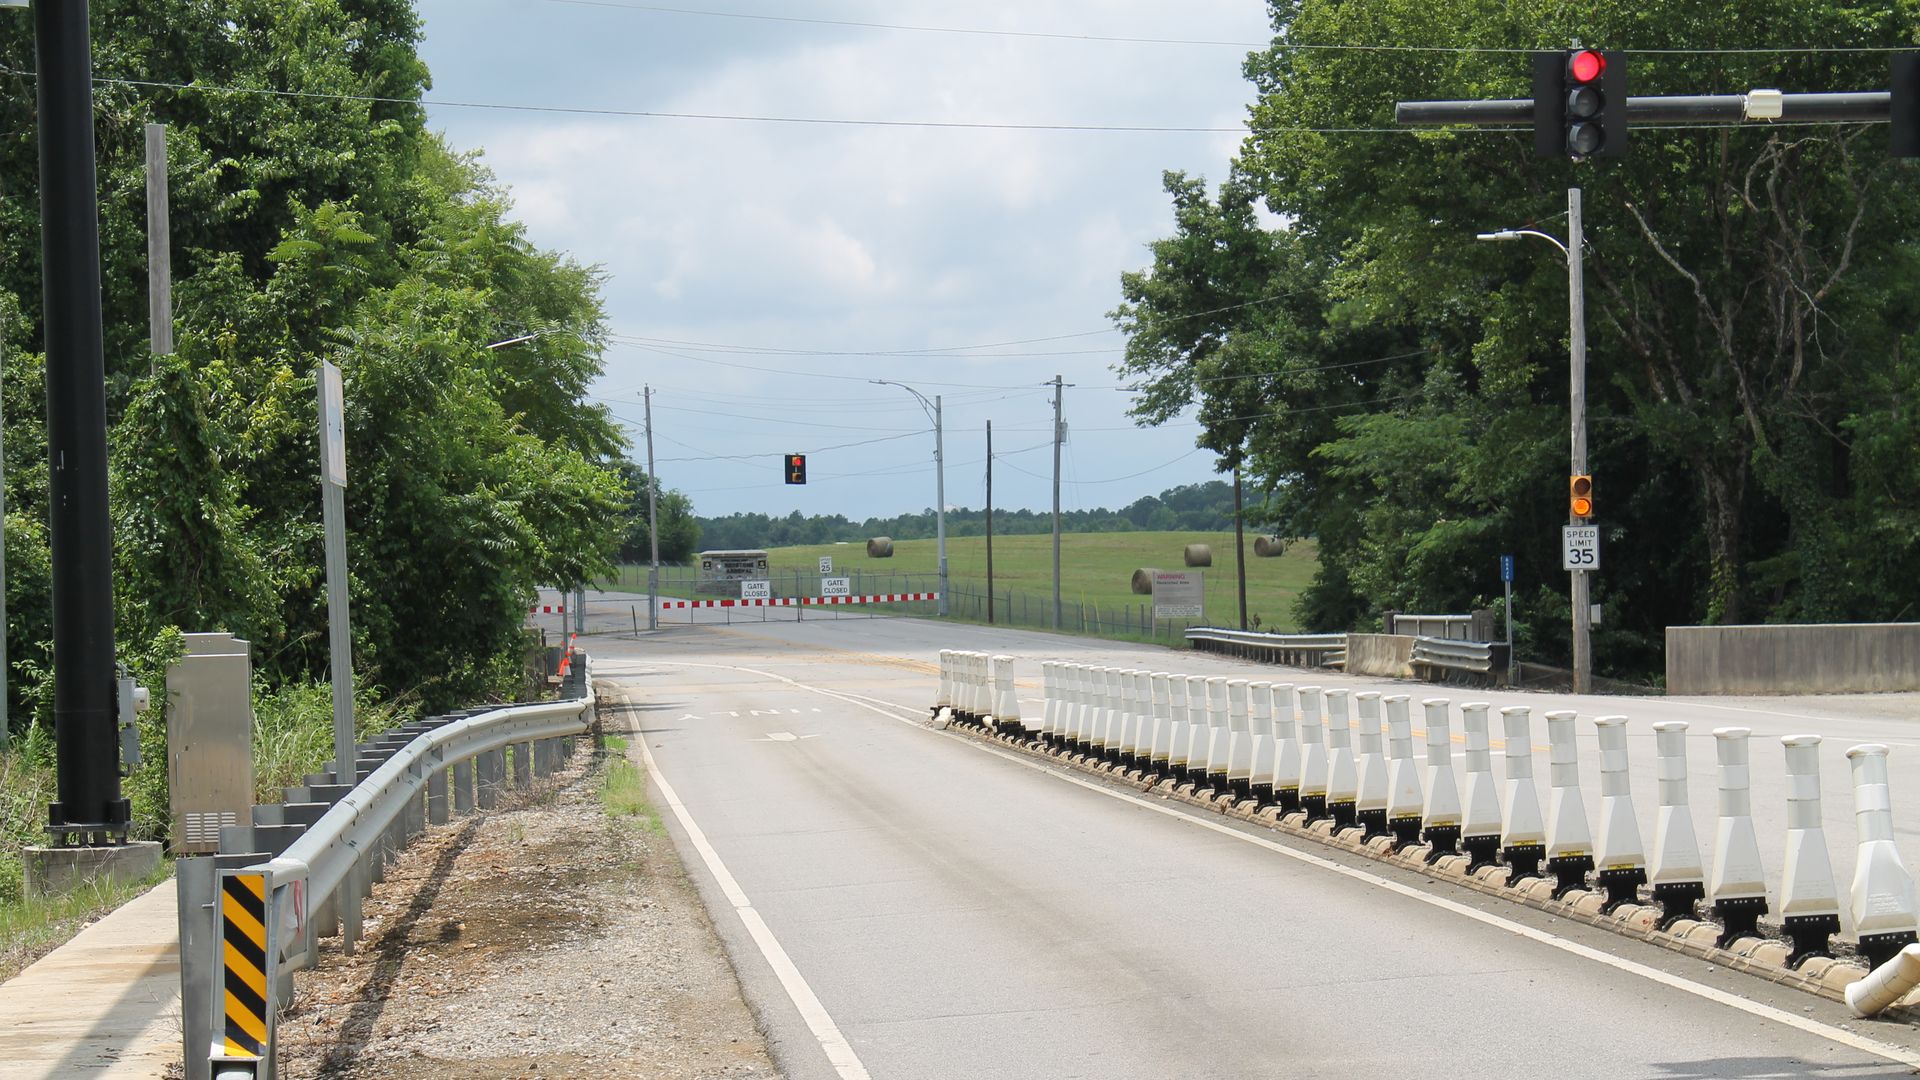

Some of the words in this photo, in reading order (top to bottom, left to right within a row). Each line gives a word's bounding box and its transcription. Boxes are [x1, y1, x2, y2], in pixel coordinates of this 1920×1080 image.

[1566, 530, 1596, 538] SPEED
[1569, 539, 1593, 547] LIMIT
[1569, 548, 1594, 565] 35
[821, 564, 831, 572] 25
